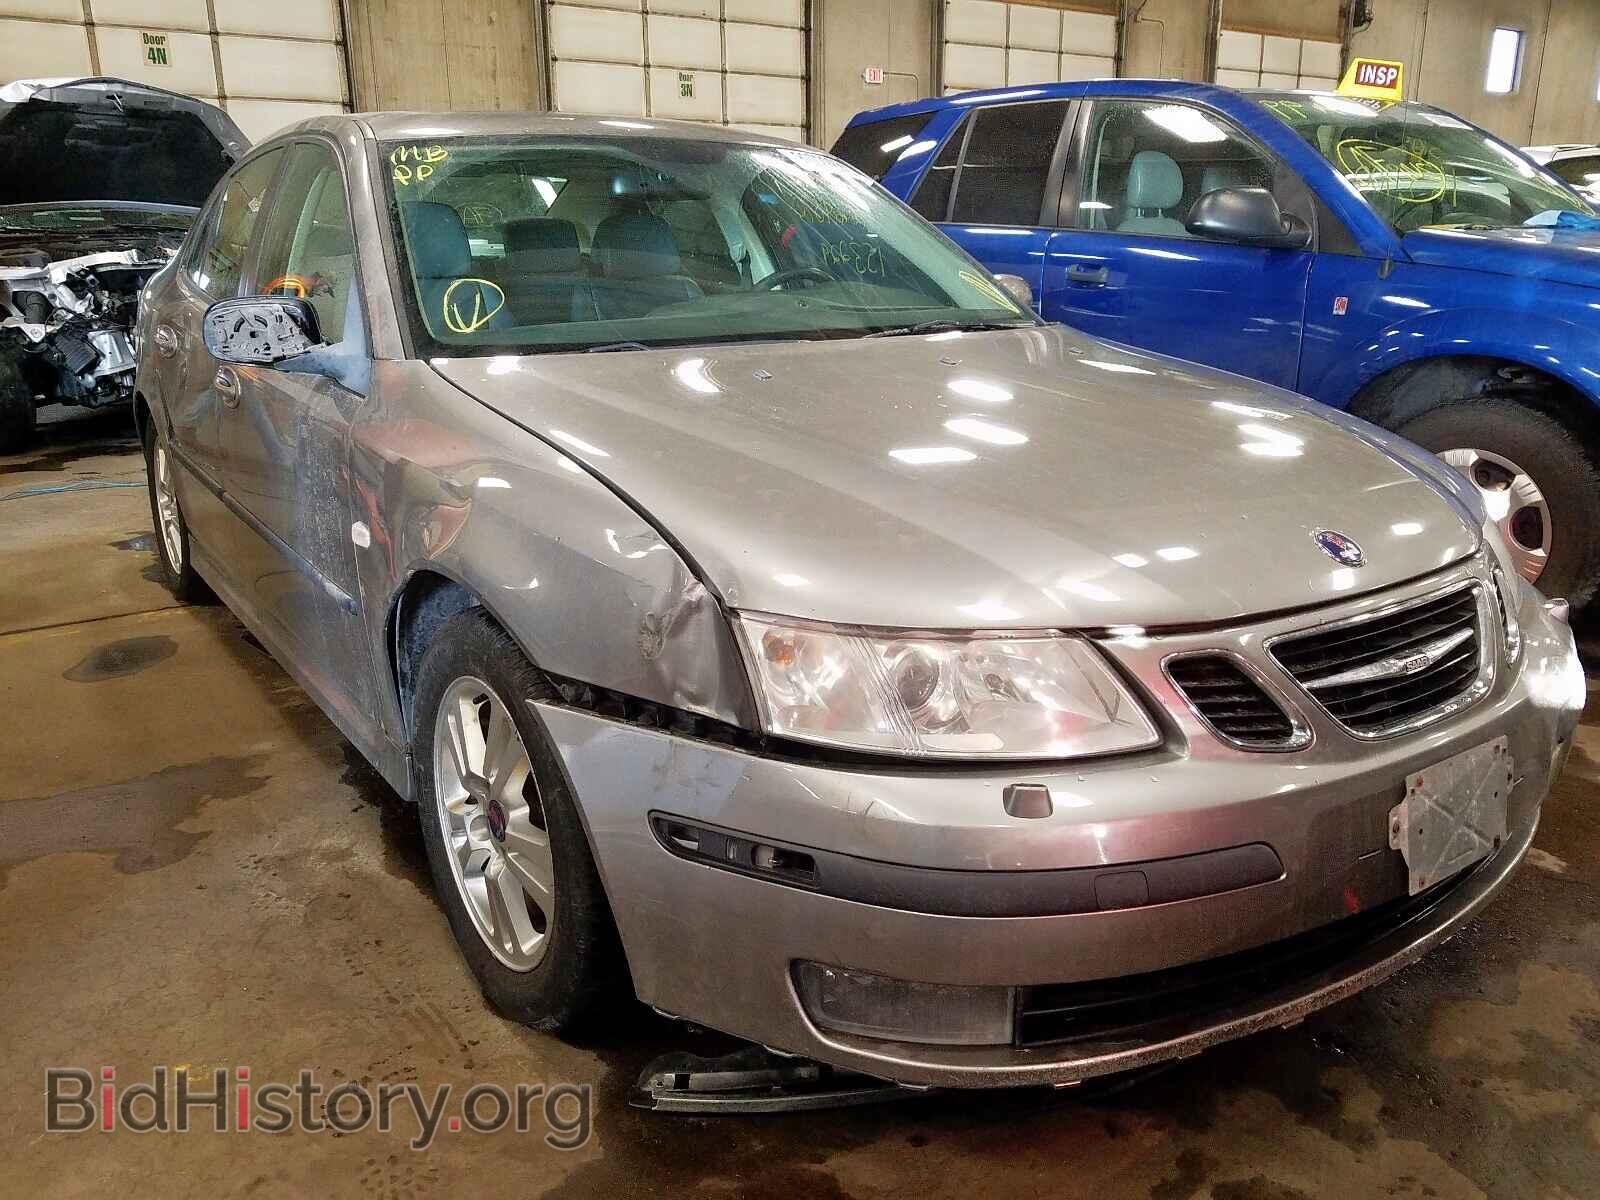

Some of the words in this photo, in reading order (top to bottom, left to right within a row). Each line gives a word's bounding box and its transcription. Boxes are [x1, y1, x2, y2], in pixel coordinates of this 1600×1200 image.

[143, 32, 166, 45] Door
[147, 46, 168, 65] 4N
[1359, 64, 1398, 86] INSP
[680, 83, 693, 97] 3N
[1405, 655, 1430, 671] SAAB
